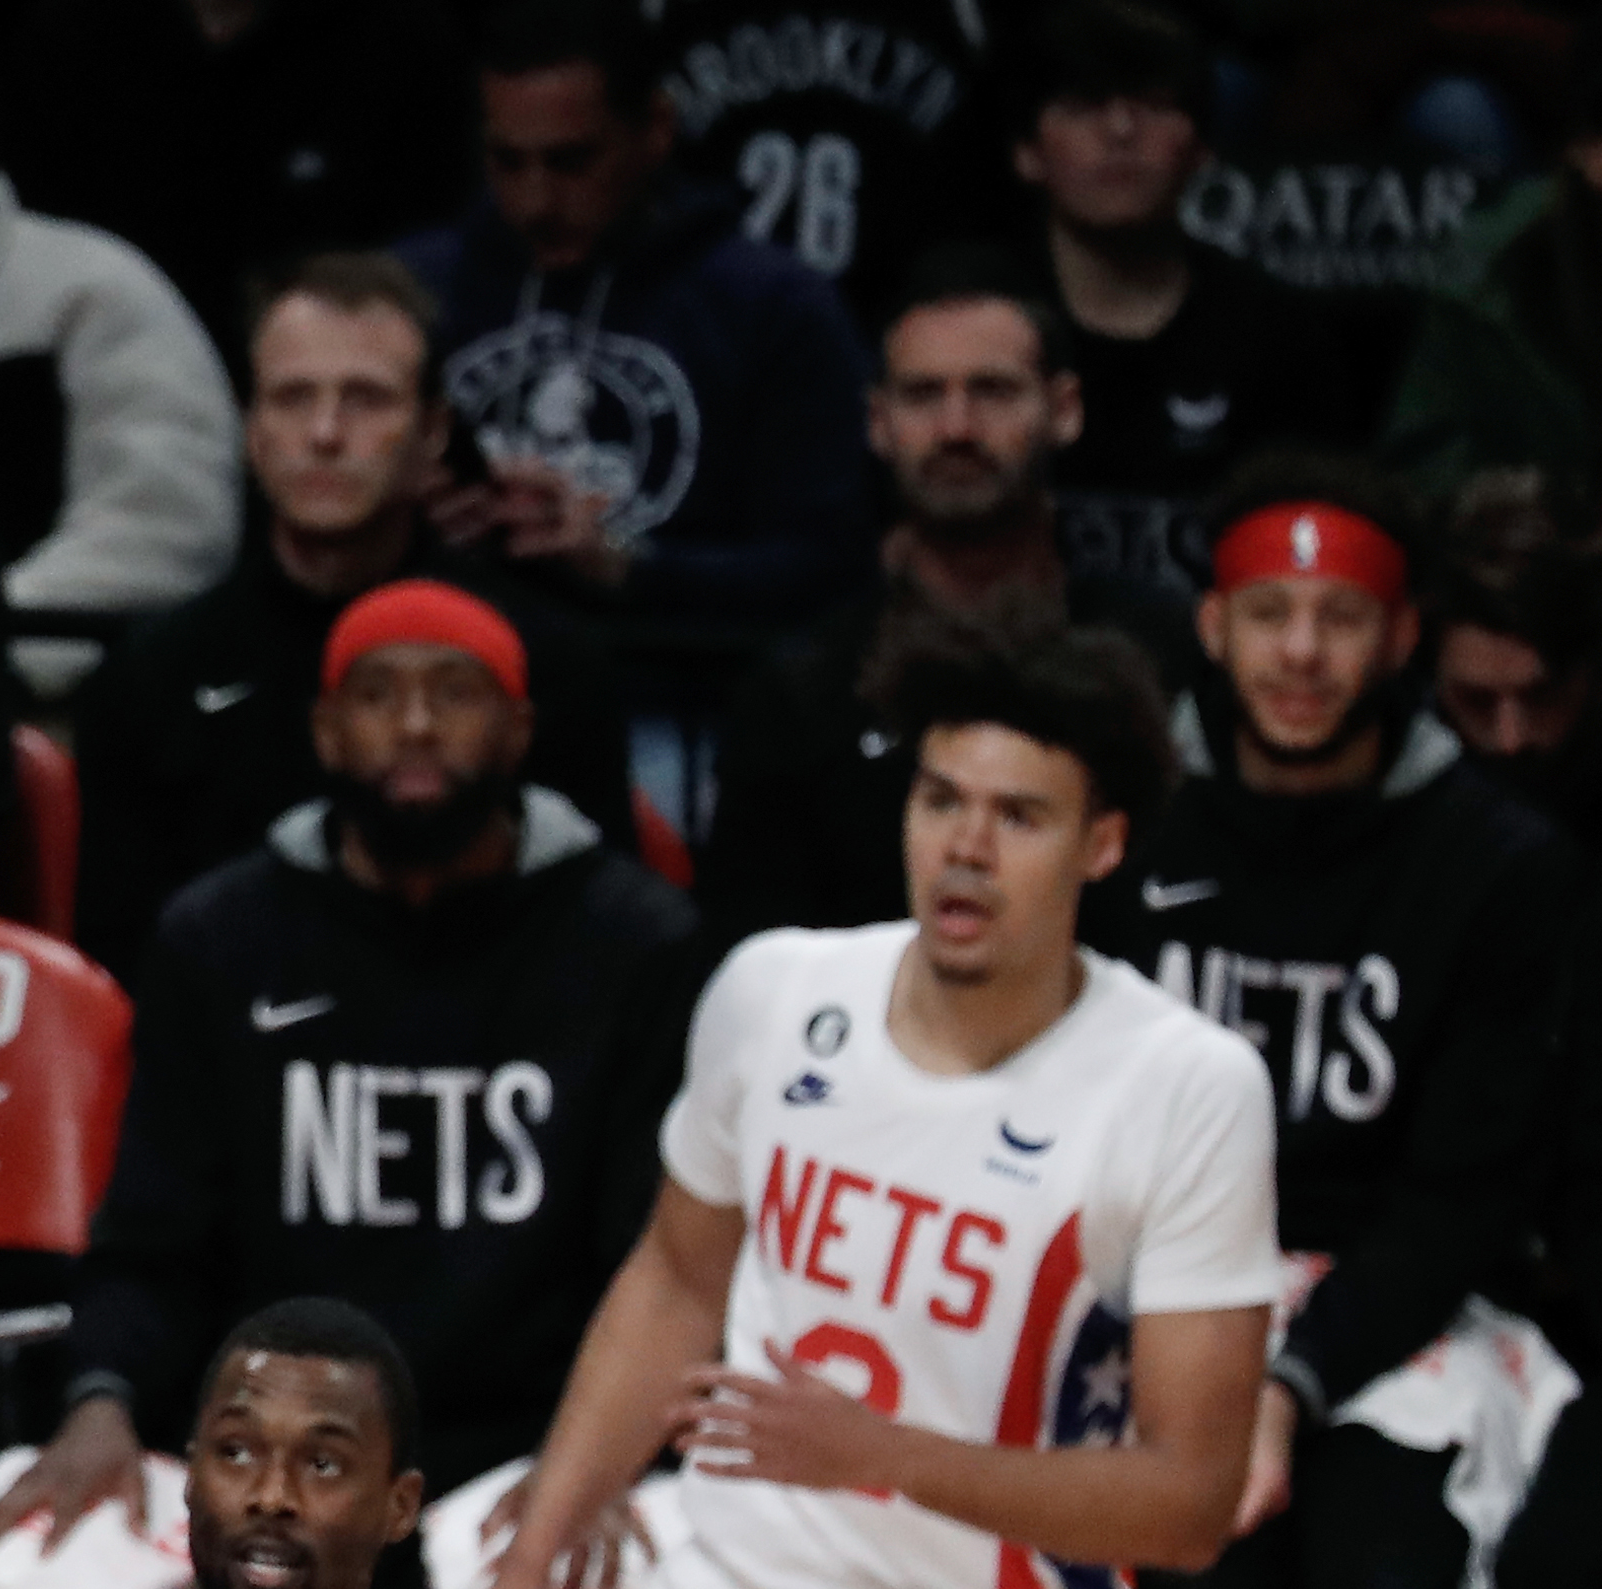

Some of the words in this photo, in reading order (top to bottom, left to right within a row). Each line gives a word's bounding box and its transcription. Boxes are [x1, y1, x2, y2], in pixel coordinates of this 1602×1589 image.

[1177, 162, 1478, 260] QATAR
[280, 1057, 555, 1232] NETS
[757, 1145, 1007, 1332] NETS
